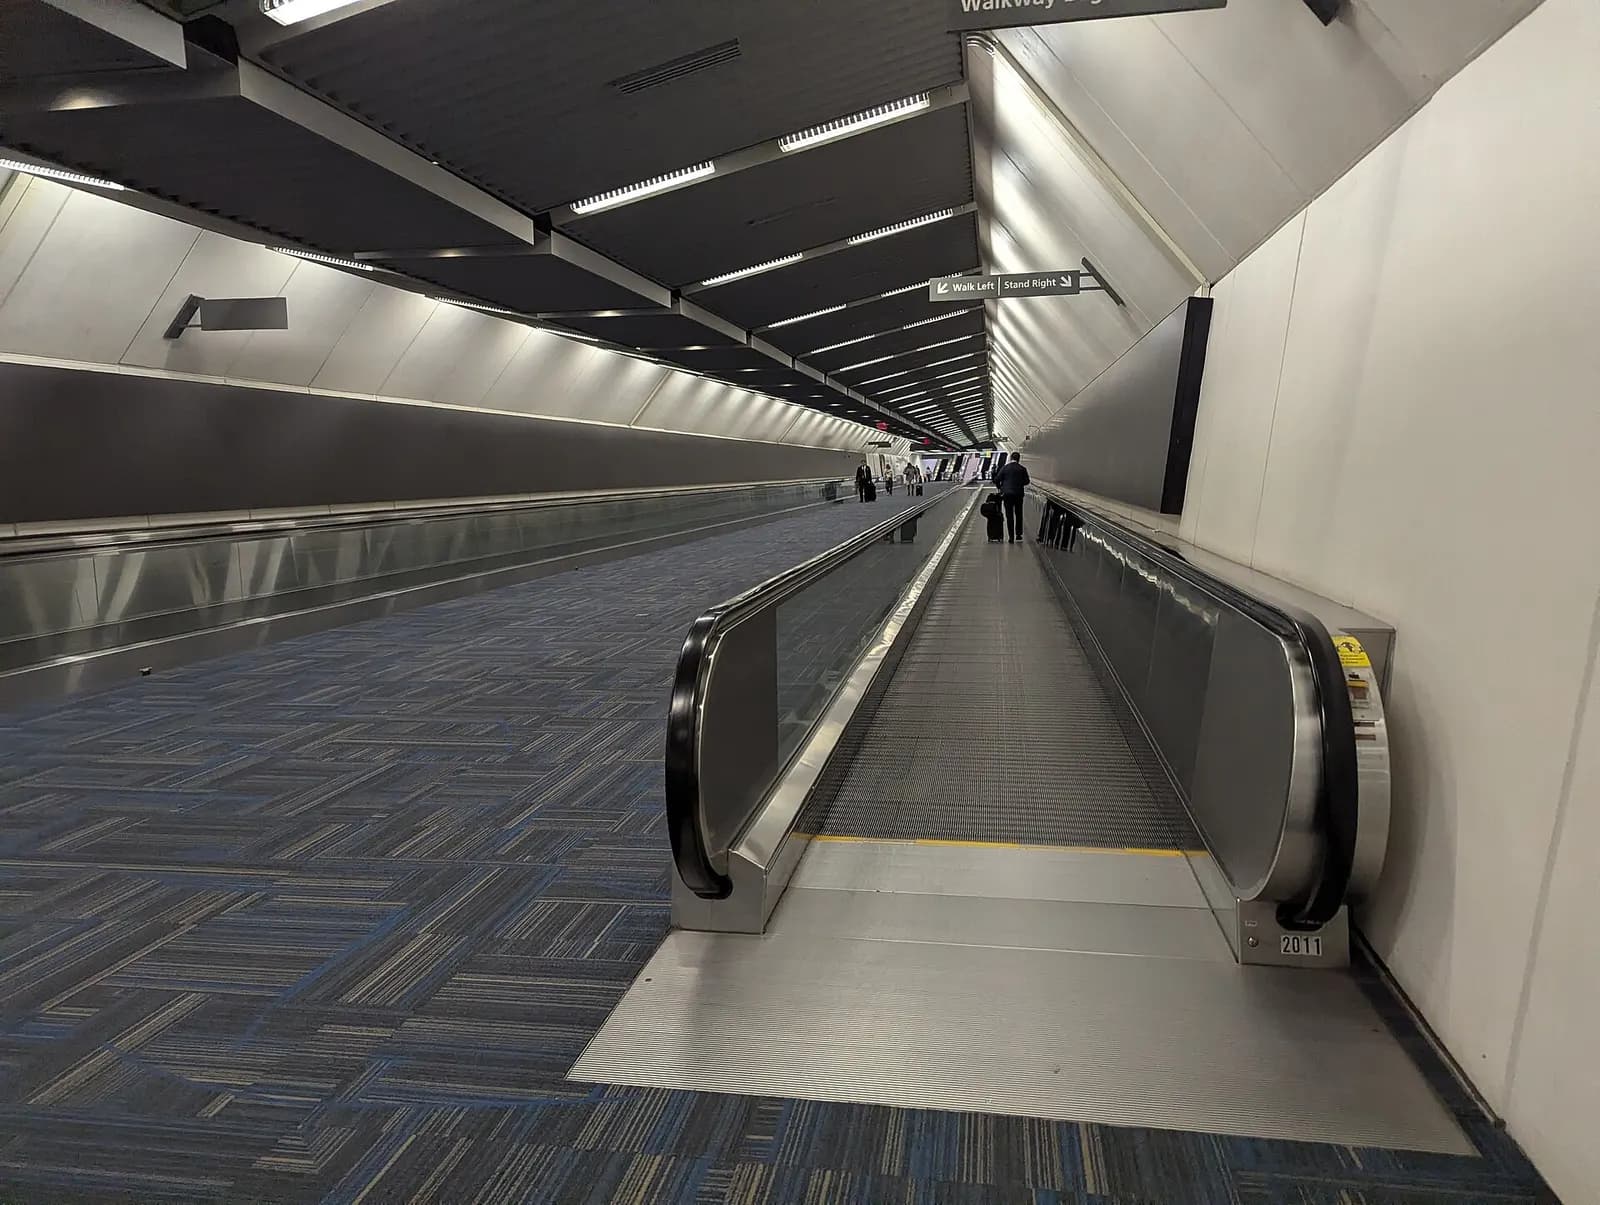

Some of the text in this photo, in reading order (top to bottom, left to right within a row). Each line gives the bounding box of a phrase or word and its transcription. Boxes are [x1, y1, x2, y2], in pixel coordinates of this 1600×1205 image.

[952, 281, 995, 292] Walk Left
[1004, 278, 1057, 290] Stand Right
[1282, 936, 1320, 955] 2011
